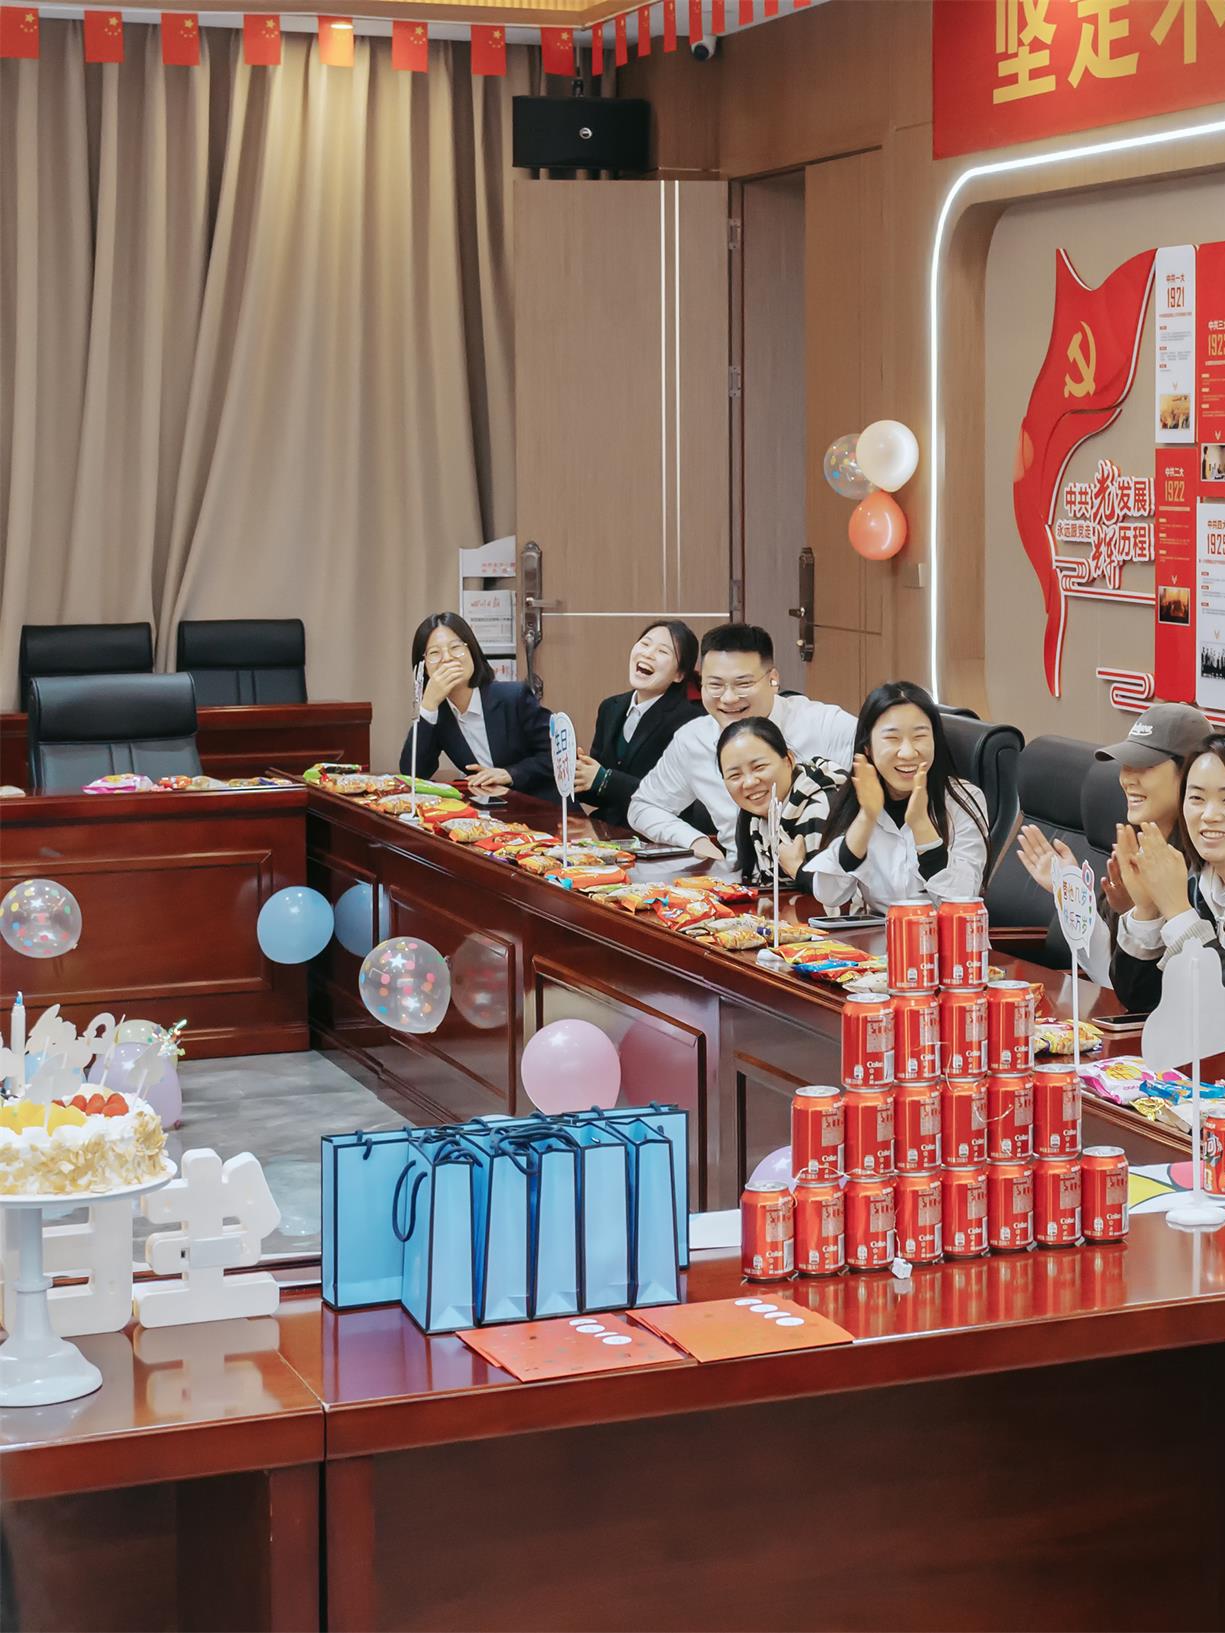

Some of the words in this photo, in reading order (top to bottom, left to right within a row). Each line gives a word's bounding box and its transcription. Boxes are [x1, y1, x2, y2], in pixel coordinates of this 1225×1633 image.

[1166, 273, 1185, 283] 中共一大
[1167, 286, 1185, 308] 1921
[1165, 467, 1185, 478] 中共二大
[1065, 485, 1090, 516] 中共
[1117, 479, 1148, 514] 发展
[1164, 480, 1185, 502] 1922
[1117, 525, 1148, 560] 历程
